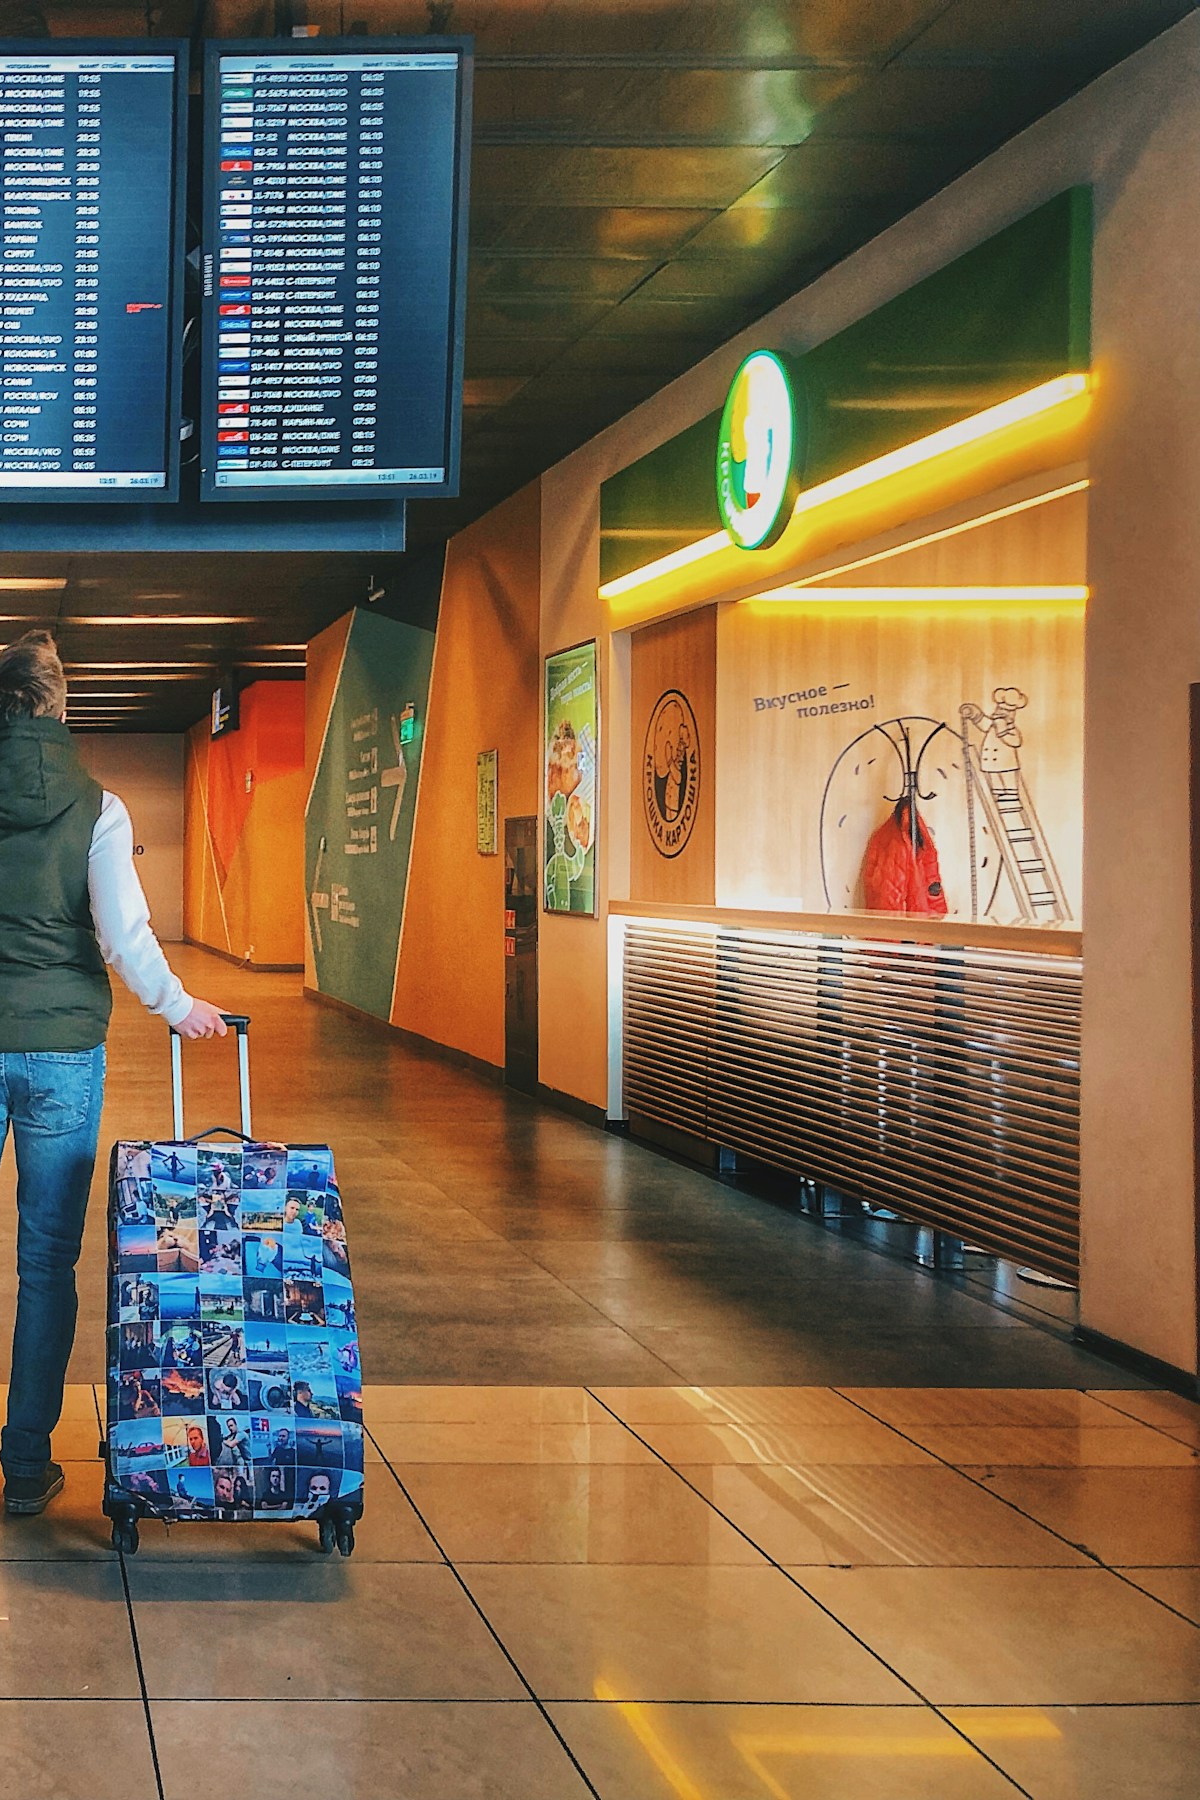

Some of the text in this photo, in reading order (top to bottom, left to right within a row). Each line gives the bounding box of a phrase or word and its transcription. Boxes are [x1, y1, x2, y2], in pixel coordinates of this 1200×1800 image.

[753, 685, 827, 712] Вкусное
[796, 694, 875, 718] полезно!
[645, 748, 697, 846] КРОШКА КАРТОШКА
